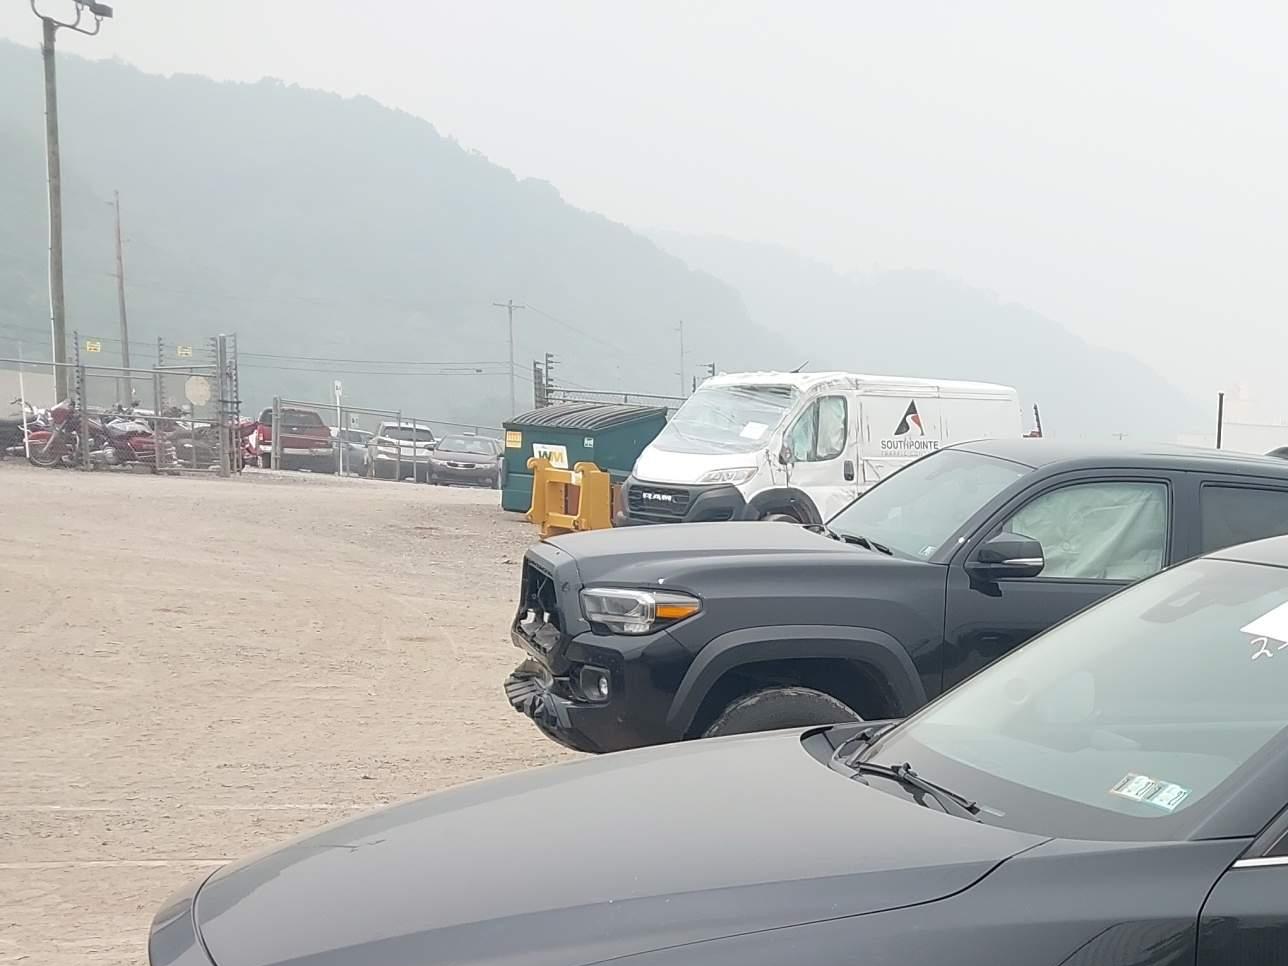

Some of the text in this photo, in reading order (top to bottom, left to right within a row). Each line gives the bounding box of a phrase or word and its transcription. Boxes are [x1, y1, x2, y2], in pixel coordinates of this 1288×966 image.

[880, 440, 939, 450] SOUTHPOINTE
[538, 450, 564, 463] WM
[642, 492, 672, 502] RAM
